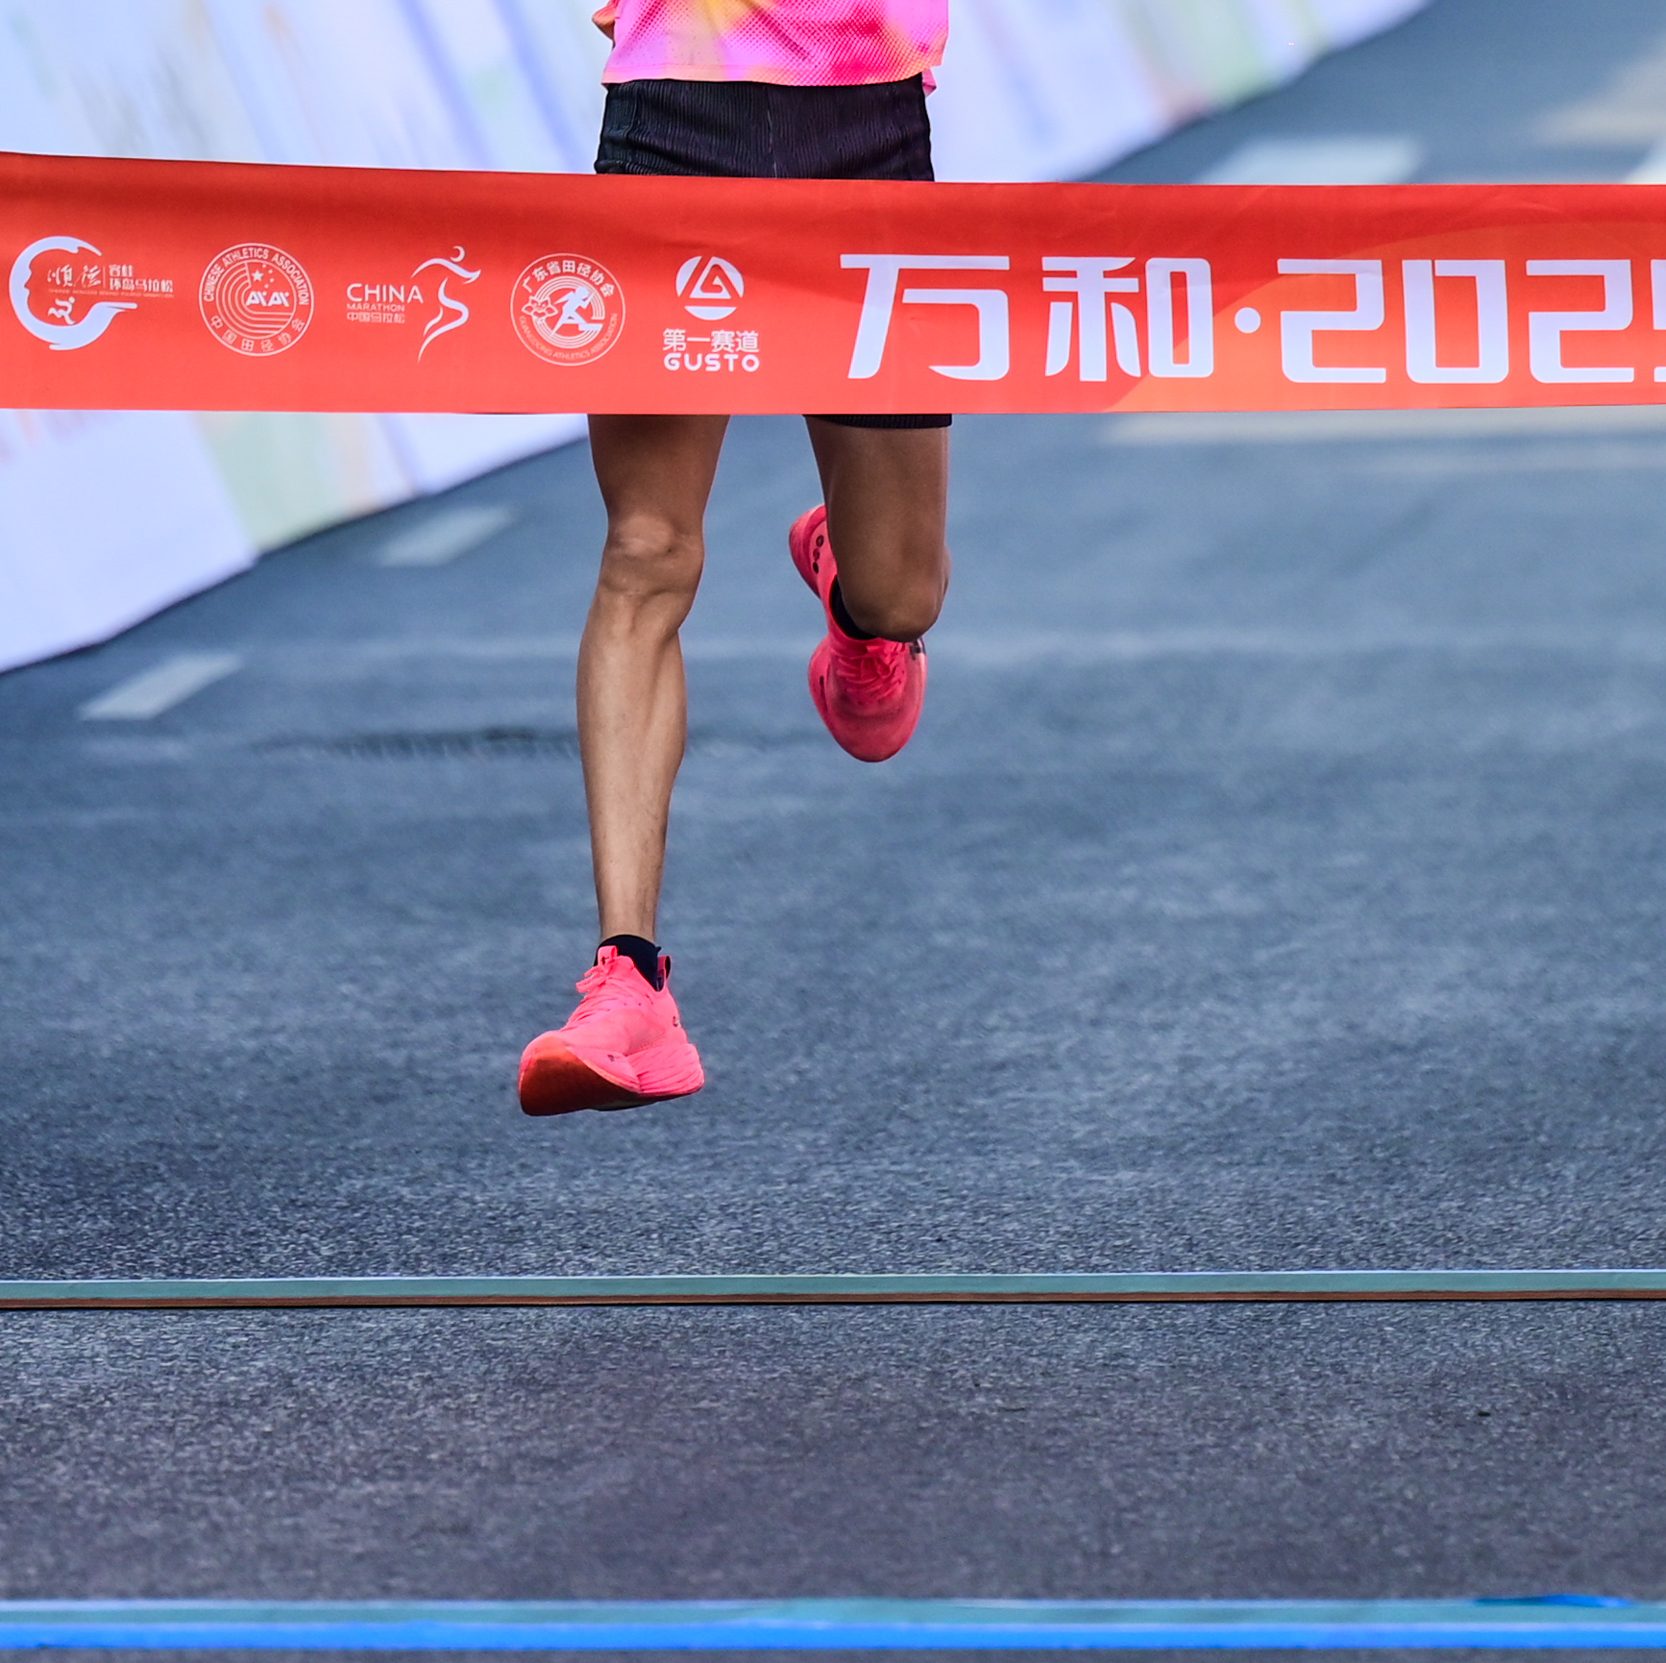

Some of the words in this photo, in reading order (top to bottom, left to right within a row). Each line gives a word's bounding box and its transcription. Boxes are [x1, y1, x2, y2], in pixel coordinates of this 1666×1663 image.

[109, 278, 174, 293] 环岛马拉松
[203, 264, 225, 302] CHINESE
[222, 247, 269, 267] ATHLETICS
[271, 253, 310, 305] ASSOCIATION
[522, 260, 615, 298] 广东省田径协会
[346, 283, 424, 304] CHINA
[347, 303, 405, 313] MARATHON
[347, 312, 405, 324] 中国马拉松
[211, 315, 305, 353] 中国田径协会
[519, 315, 553, 356] GUANGDONG
[553, 350, 590, 361] ATHLETICS
[590, 312, 618, 355] ASSOCIATION
[663, 328, 760, 353] 第一赛道
[664, 352, 760, 372] GUSTO
